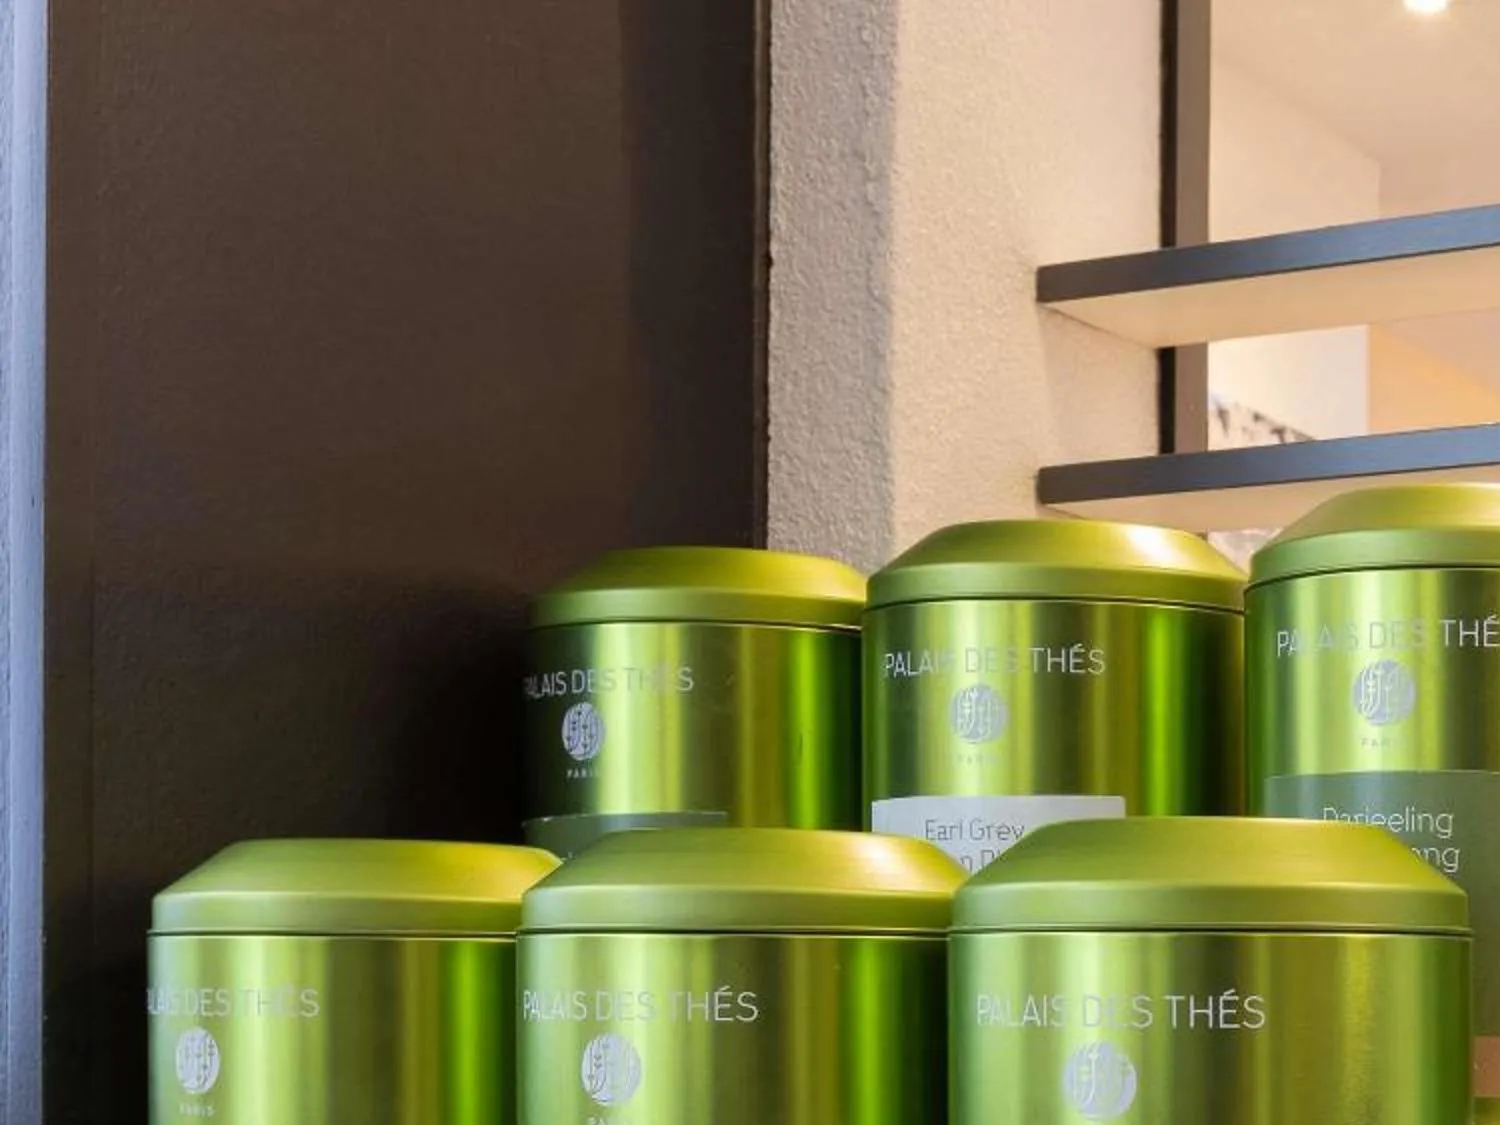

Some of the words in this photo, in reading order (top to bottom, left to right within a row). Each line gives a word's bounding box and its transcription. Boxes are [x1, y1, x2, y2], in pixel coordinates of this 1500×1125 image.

[1029, 643, 1106, 675] THÉS
[925, 818, 963, 841] Earl
[522, 989, 588, 1021] PALAIS
[595, 990, 656, 1021] DES
[669, 985, 760, 1022] THÉS
[976, 993, 1068, 1028] PALAIS
[1166, 988, 1266, 1030] THÉS
